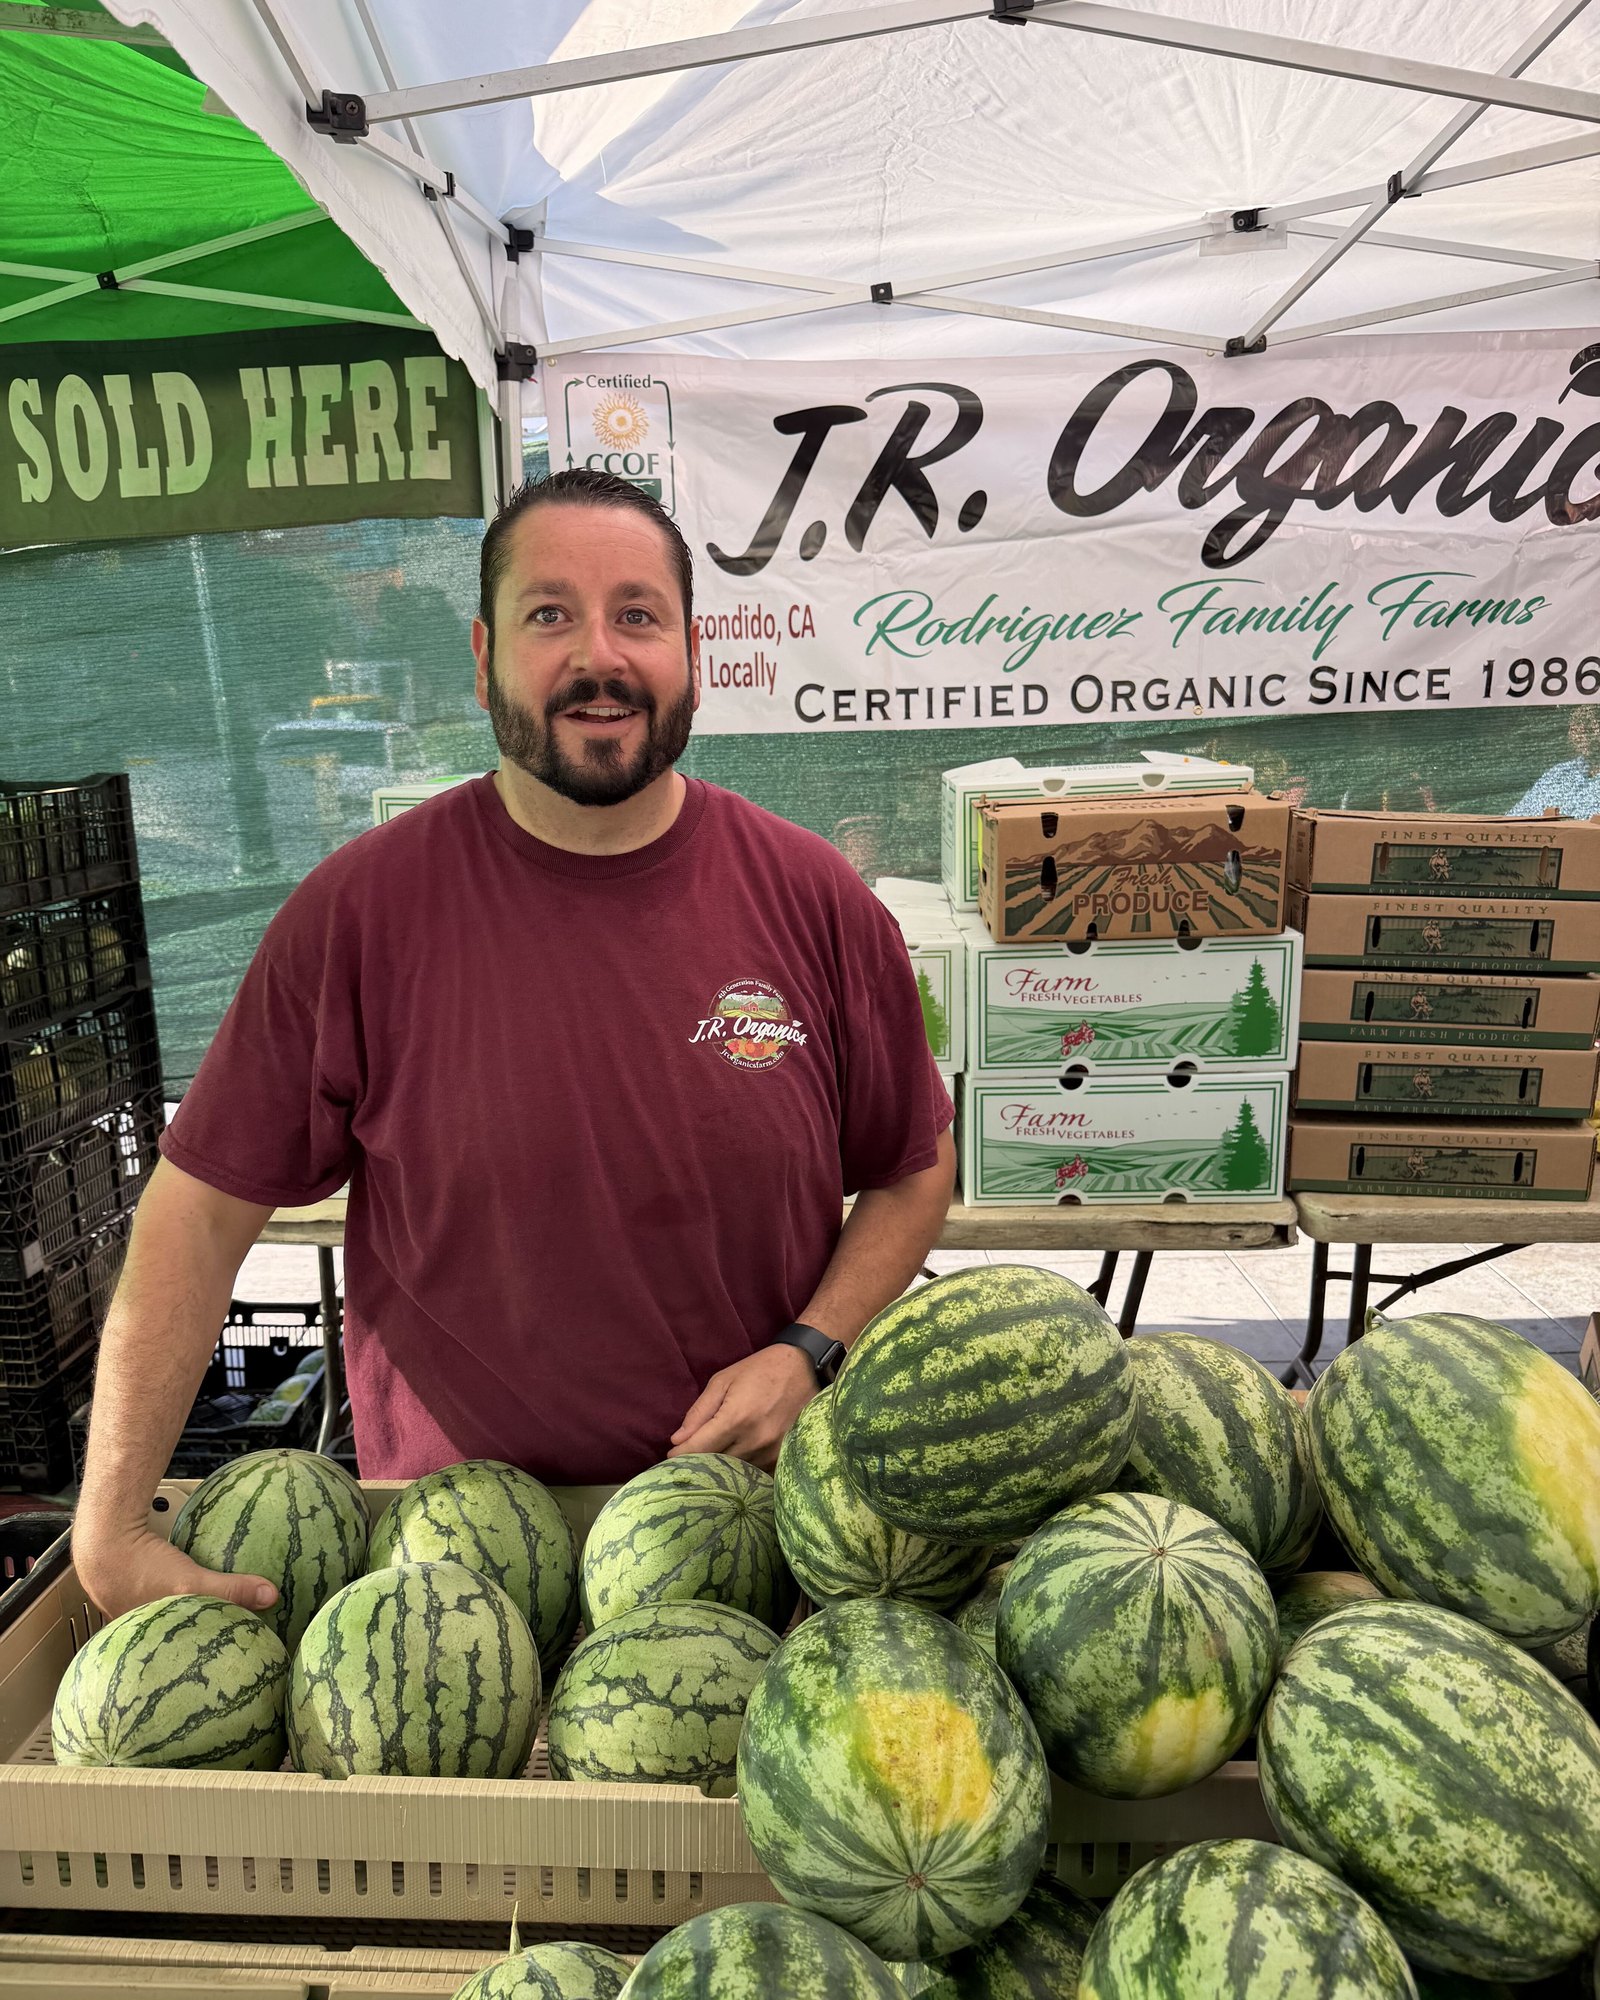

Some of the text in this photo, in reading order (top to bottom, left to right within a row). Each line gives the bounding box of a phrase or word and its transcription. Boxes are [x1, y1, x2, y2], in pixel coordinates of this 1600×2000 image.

[585, 374, 651, 389] Certified
[8, 356, 453, 503] SOLD HERE
[585, 452, 660, 476] CCOF
[706, 380, 989, 578] J.R.
[788, 604, 816, 639] CA
[854, 571, 1552, 673] Rodriguez Family Farms
[709, 651, 777, 696] Locally
[796, 656, 1600, 725] CERTIFIED ORGANIC SINCE 1986
[1380, 831, 1557, 844] FINEST QUALITY
[1111, 866, 1173, 891] Fresh
[1073, 890, 1209, 915] PRODUCE
[1373, 903, 1550, 915] FINEST QUALITY
[1360, 958, 1544, 971] FARM FRESH PRODUCE
[1004, 968, 1099, 996] Farm
[1362, 972, 1537, 985] FINEST QUALITY
[725, 979, 755, 993] Generation
[755, 980, 773, 993] Family
[772, 988, 784, 1003] Farm
[1020, 992, 1143, 1005] FRESH VEGETABLES
[688, 1015, 808, 1046] J.R. Organics
[1350, 1027, 1531, 1042] FARM FRESH PRODUCE
[1364, 1051, 1538, 1063] FINEST QUALITY
[1000, 1103, 1093, 1130] Farm
[1016, 1126, 1135, 1140] FRESH VEGETABLES
[1357, 1132, 1532, 1145] FINEST QUALITY
[1347, 1184, 1529, 1199] FARM FRESH PRODUCE
